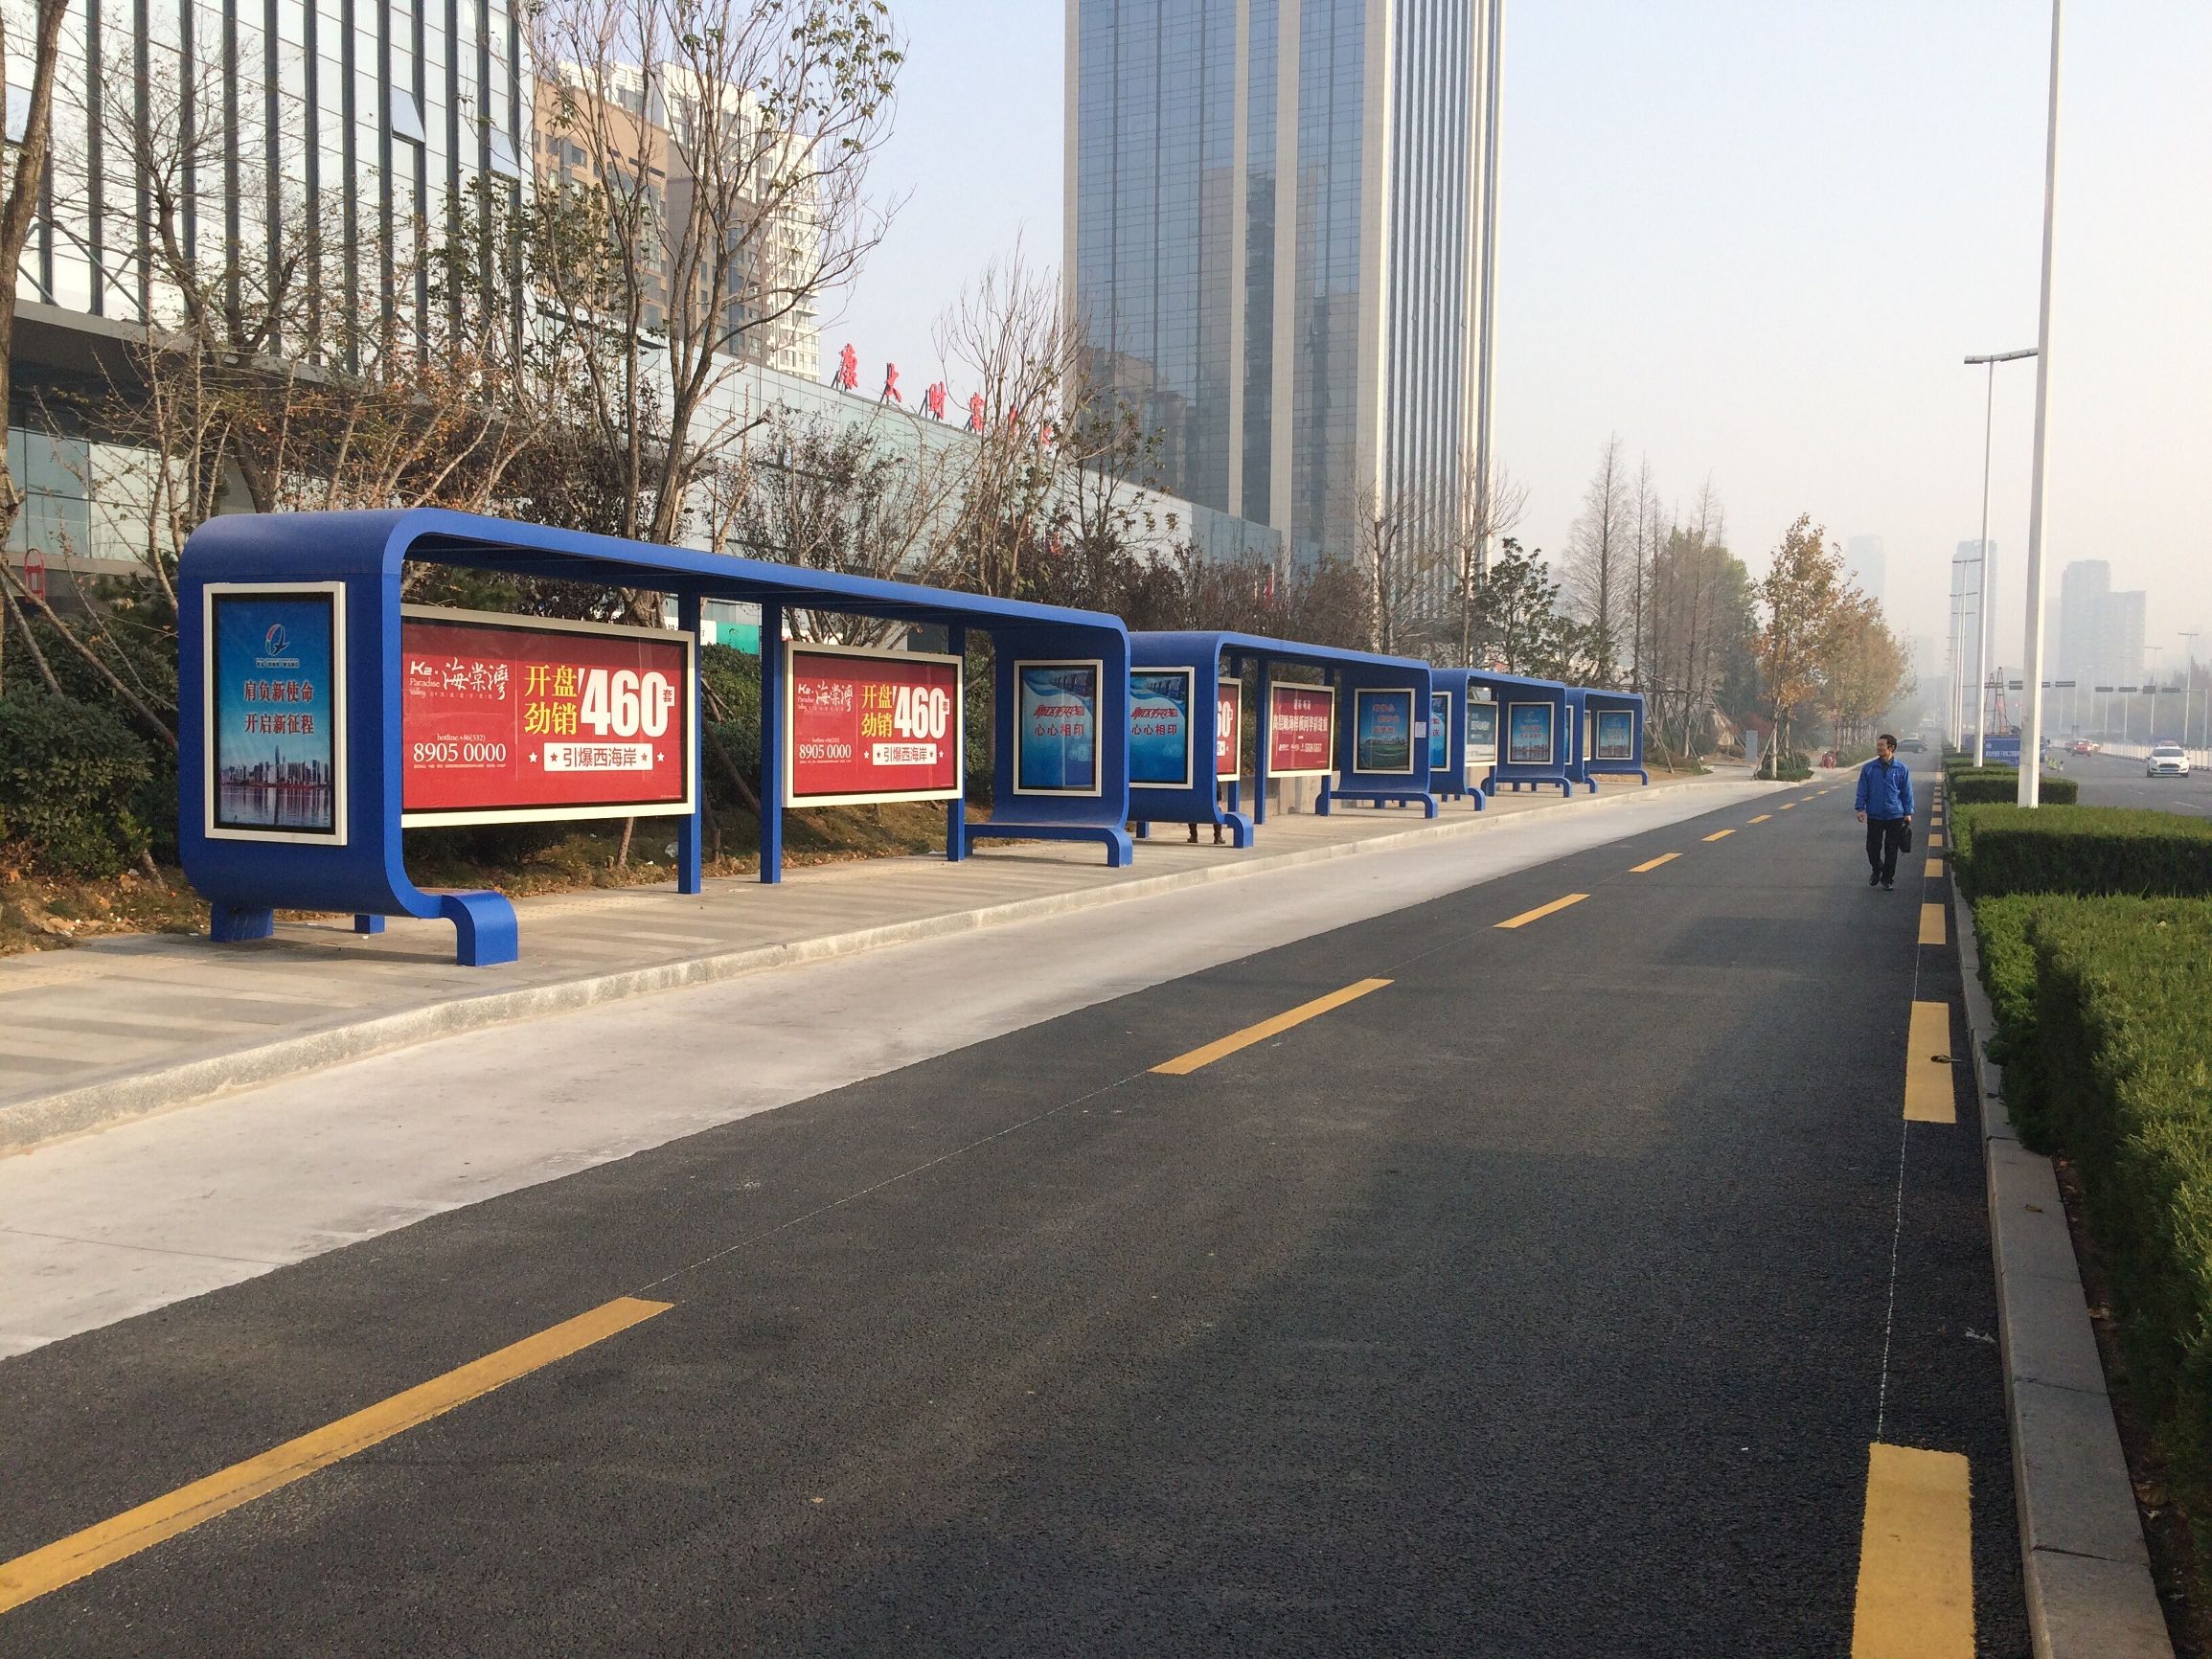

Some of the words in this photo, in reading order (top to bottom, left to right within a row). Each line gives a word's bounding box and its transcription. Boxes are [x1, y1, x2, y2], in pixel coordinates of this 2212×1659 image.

[244, 680, 314, 702] 肩负新使命
[524, 664, 578, 697] 开盘
[860, 683, 893, 709] 开盘
[244, 713, 314, 736] 开启新征程
[523, 701, 578, 736] 劲销
[860, 712, 893, 739] 劲销
[1034, 723, 1084, 737] 心心相印
[1131, 723, 1177, 736] 心心相印
[413, 742, 459, 762] 8905
[463, 742, 507, 762] 0000
[562, 747, 637, 767] 引爆西海岸
[799, 744, 825, 760] 8905
[827, 744, 852, 760] 0000
[883, 746, 927, 762] 引爆西海岸
